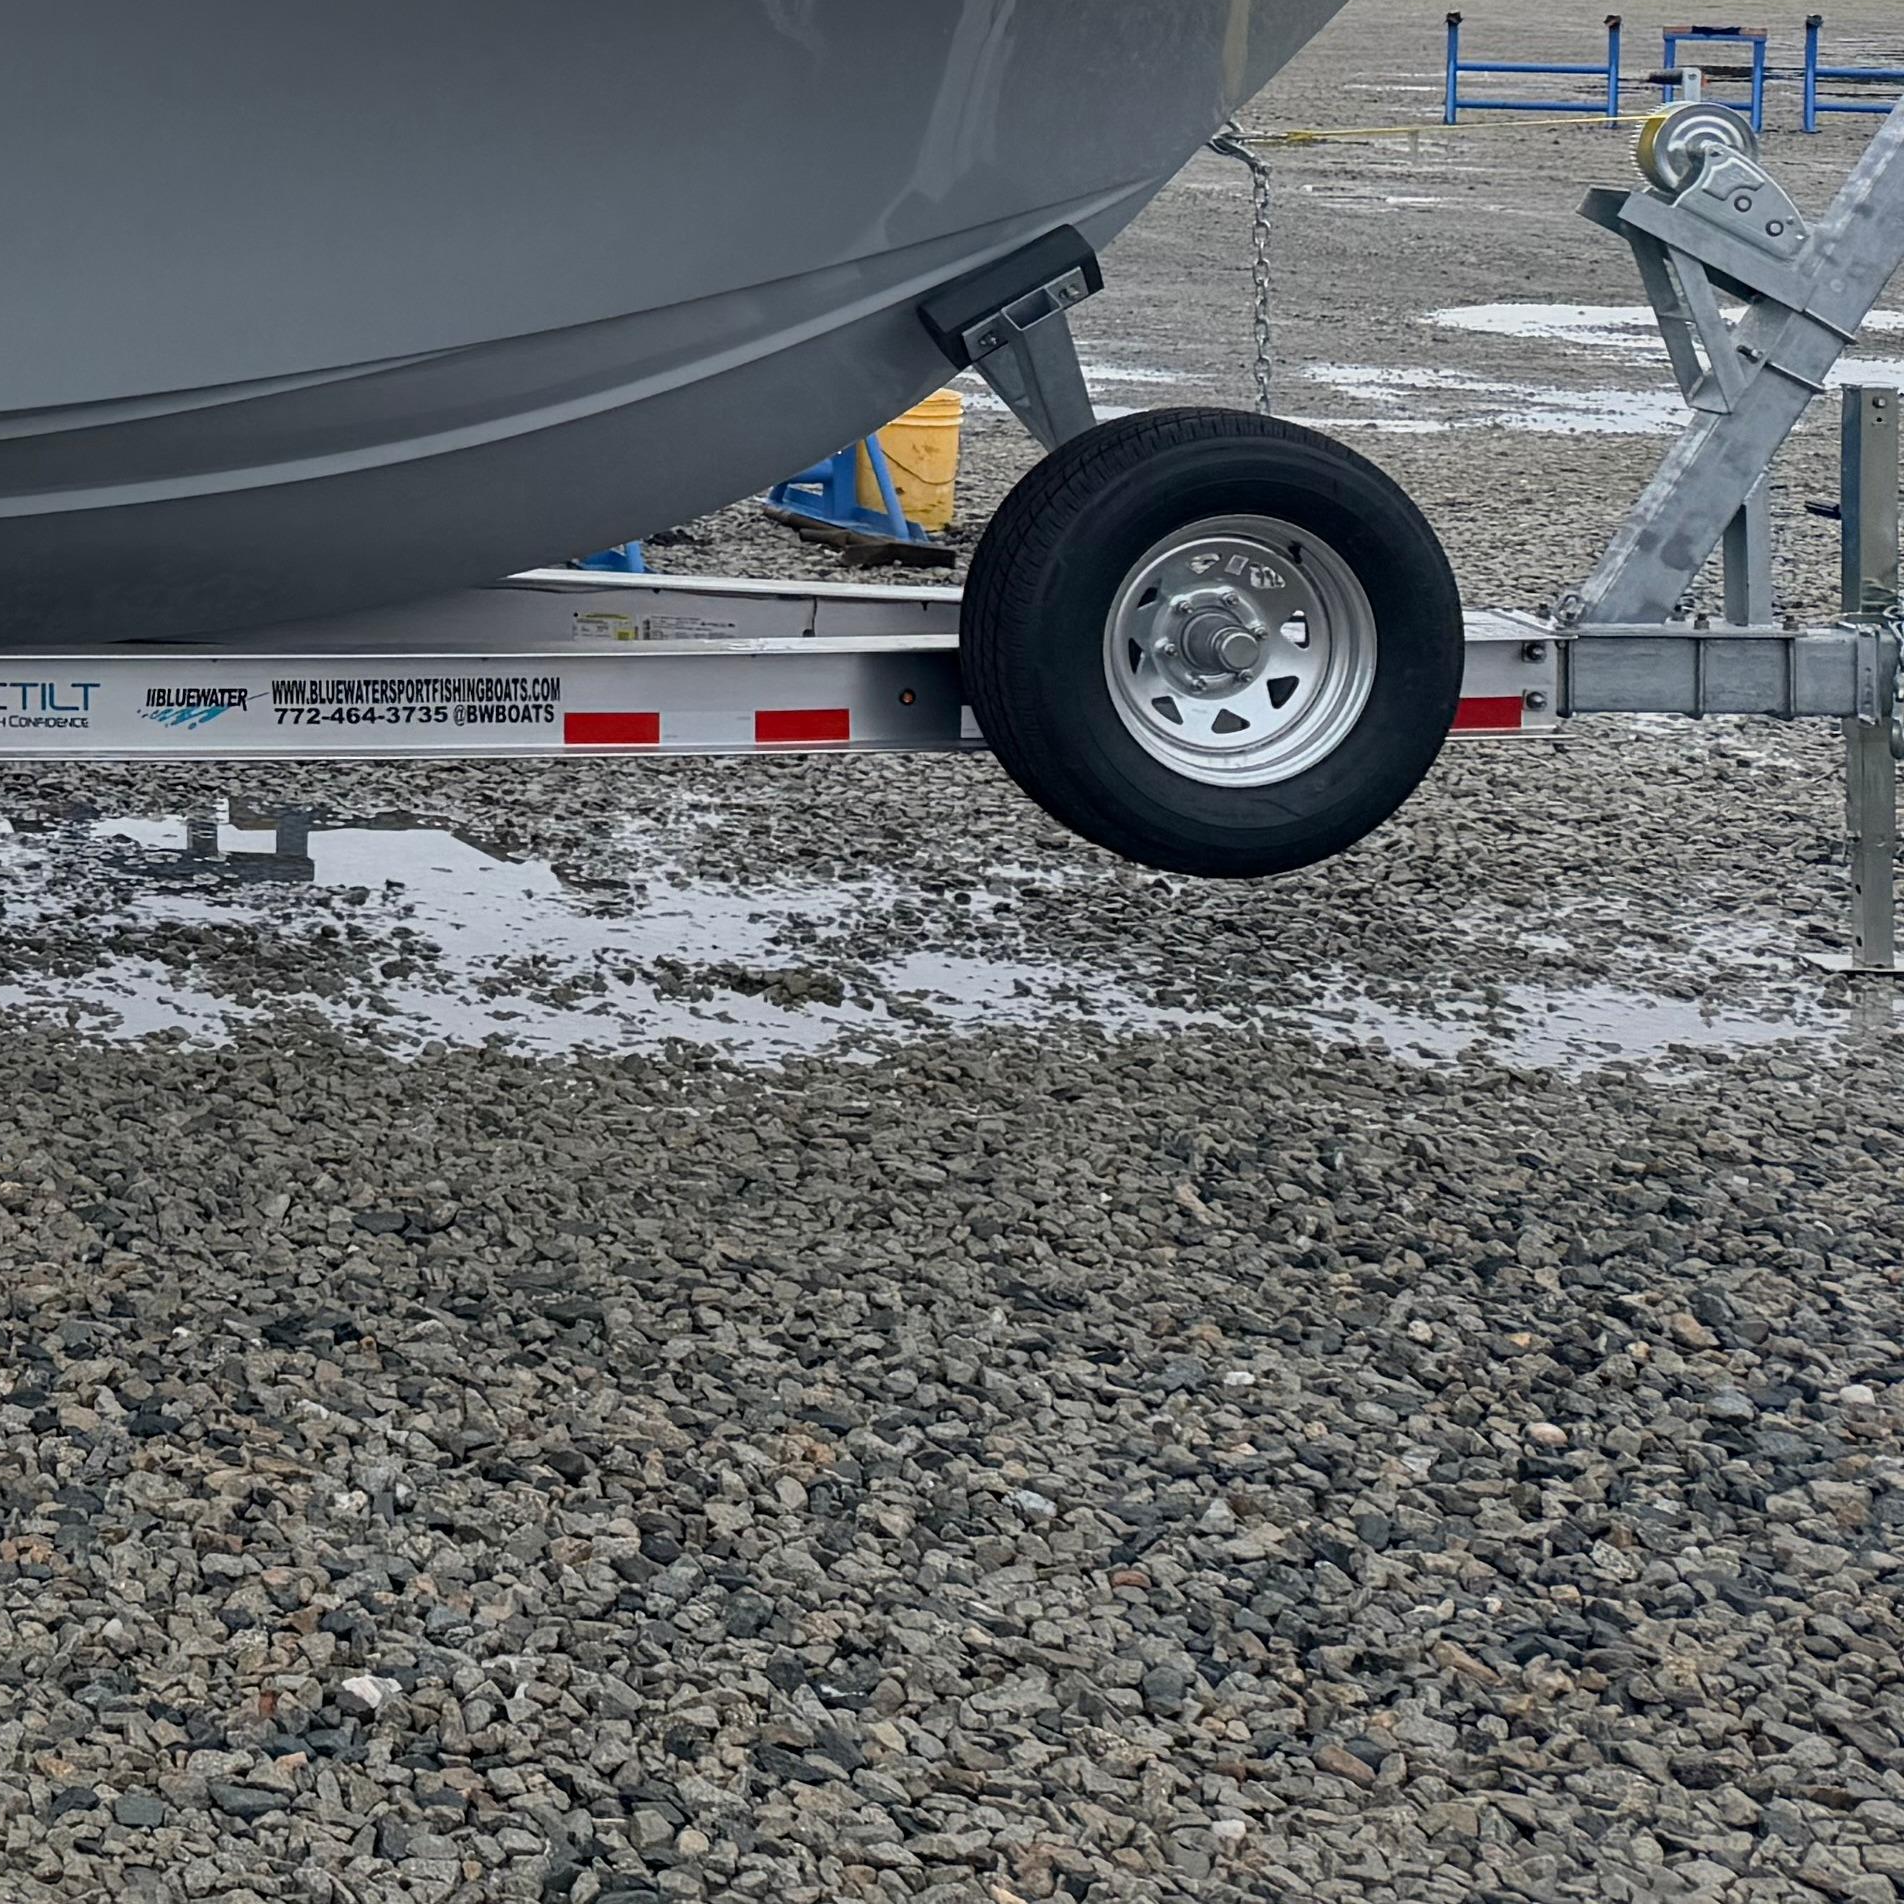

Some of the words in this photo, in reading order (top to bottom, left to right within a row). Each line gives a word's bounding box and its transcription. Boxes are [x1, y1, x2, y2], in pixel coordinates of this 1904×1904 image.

[271, 677, 561, 705] WWW.BLUEWATERSPORTFISHINGBOATS.COM
[8, 715, 90, 729] CONFIDENCE
[274, 706, 449, 725] 772-464-3735
[453, 704, 555, 727] @BWBOATS
